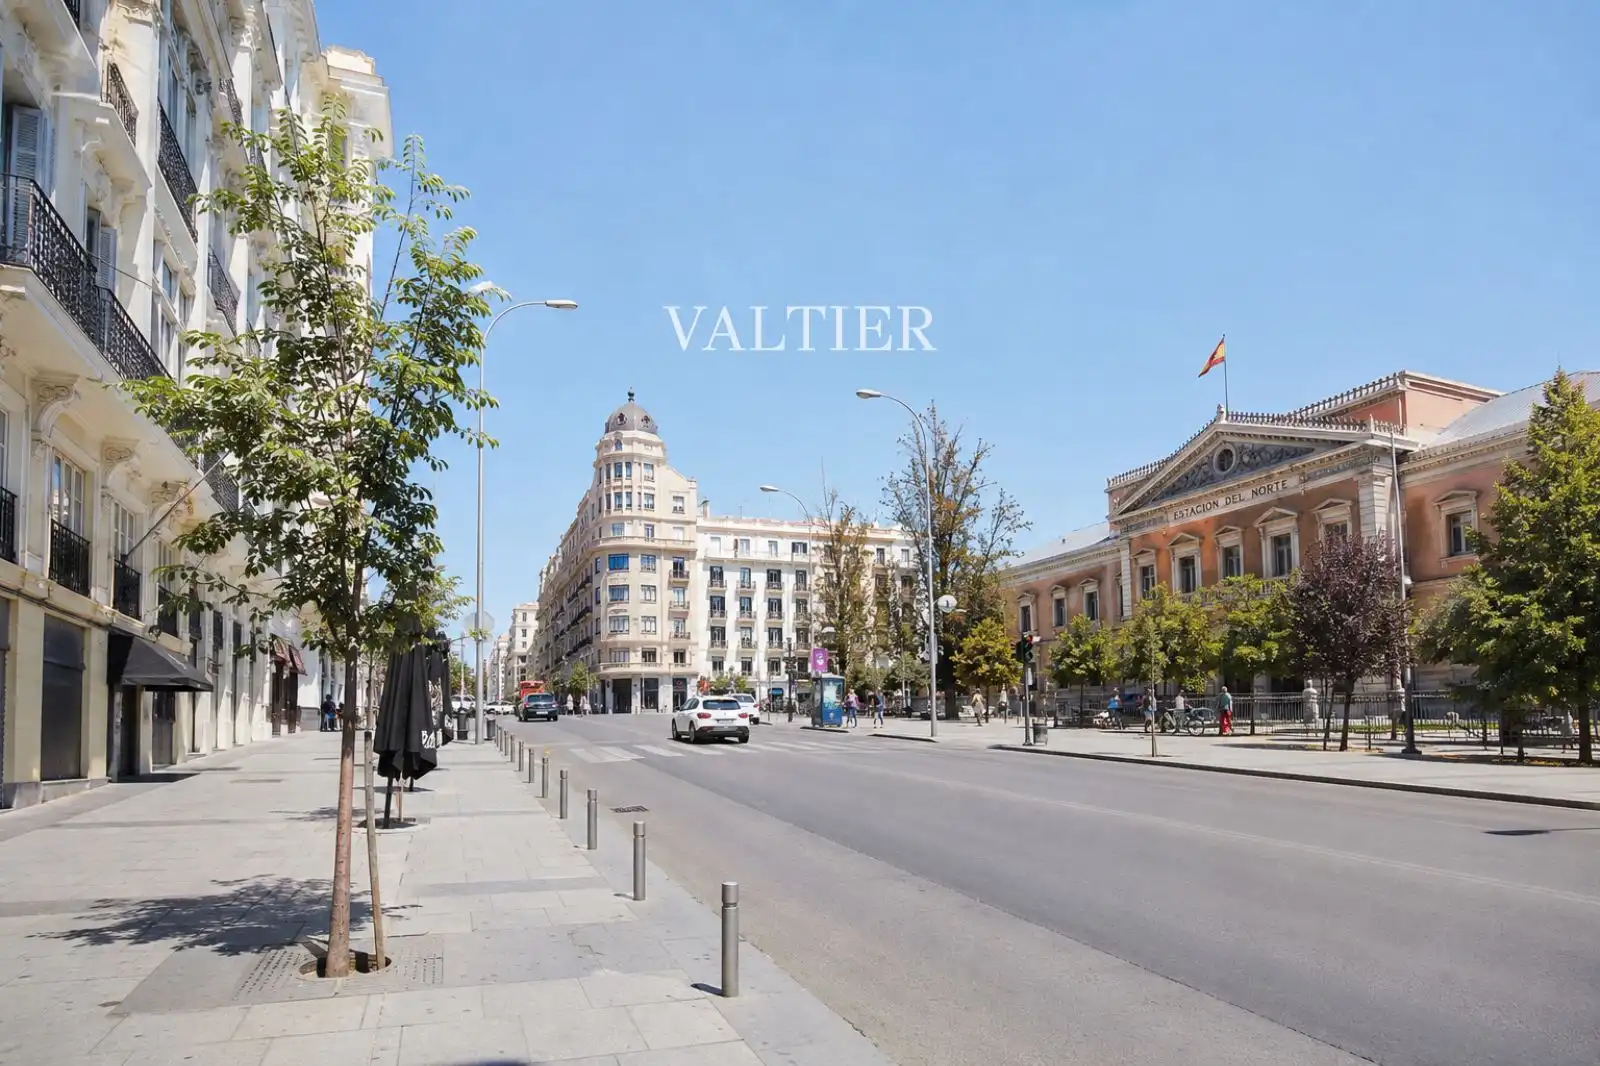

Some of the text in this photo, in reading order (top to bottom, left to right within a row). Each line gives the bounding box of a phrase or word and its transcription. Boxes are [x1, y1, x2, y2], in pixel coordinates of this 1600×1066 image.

[1174, 480, 1288, 520] ESTACION DEL NORTE
